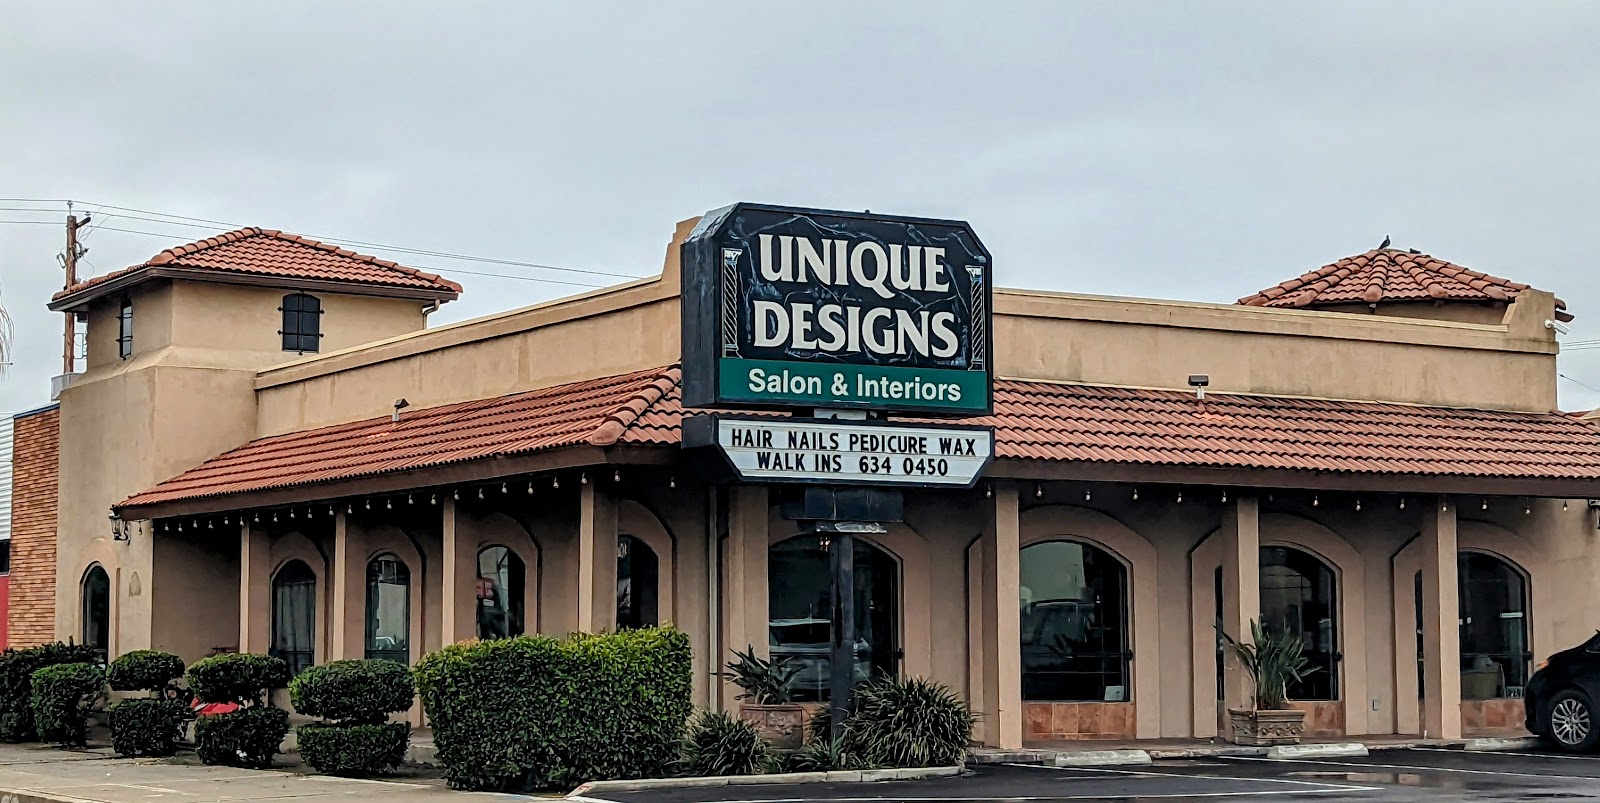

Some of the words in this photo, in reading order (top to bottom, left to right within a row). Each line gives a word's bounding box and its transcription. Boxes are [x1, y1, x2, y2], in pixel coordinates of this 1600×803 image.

[759, 234, 949, 298] UNIQUE
[753, 301, 958, 357] DESIGNS
[749, 369, 821, 394] Salon
[831, 373, 848, 395] &
[858, 374, 961, 401] Interiors
[732, 429, 772, 448] HAIR
[787, 431, 838, 450] NAILS
[848, 434, 927, 453] PEDICURE
[939, 438, 975, 456] WAX
[757, 452, 805, 471] WALK
[814, 454, 842, 473] INS
[859, 456, 891, 474] 634
[903, 458, 948, 476] 0450
